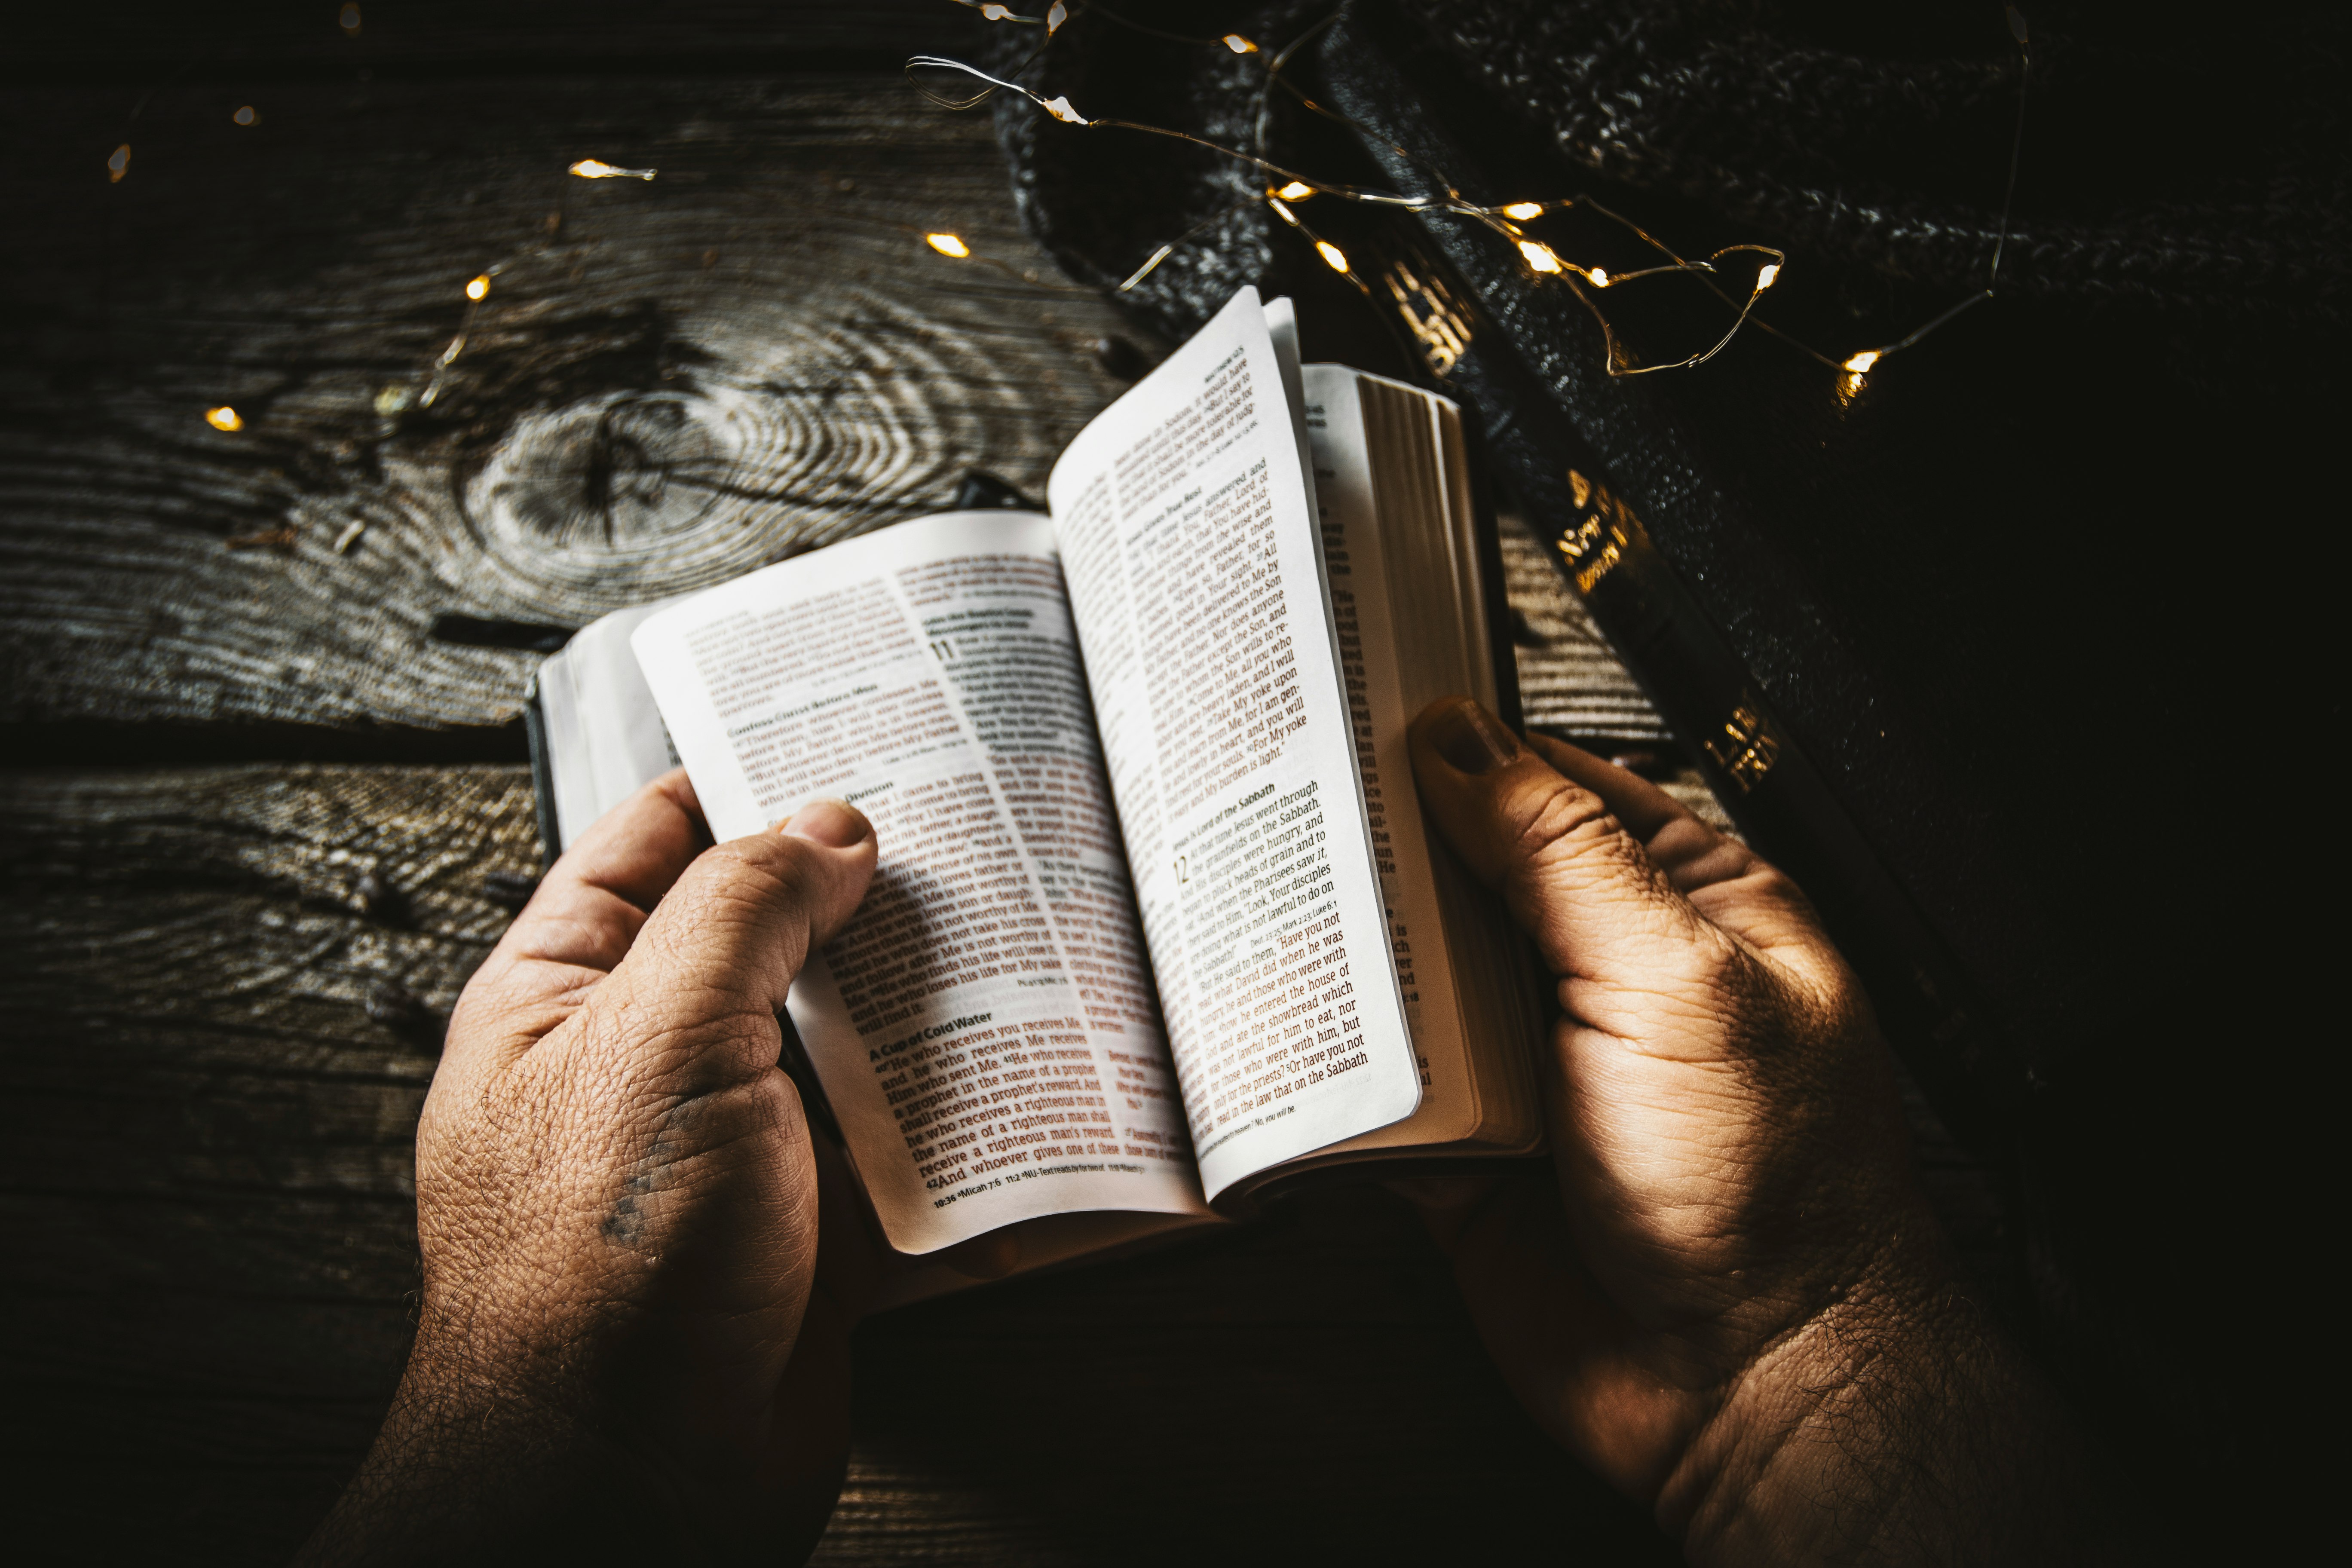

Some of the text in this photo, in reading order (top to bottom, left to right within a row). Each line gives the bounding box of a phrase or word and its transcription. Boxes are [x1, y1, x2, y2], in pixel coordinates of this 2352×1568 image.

[929, 640, 954, 661] 11
[727, 718, 773, 738] Confess
[775, 705, 810, 722] Christ
[811, 693, 850, 710] Before
[1269, 726, 1285, 743] My
[1286, 714, 1307, 736] yoke
[1250, 760, 1257, 772] is
[845, 781, 894, 804] Division
[1197, 819, 1214, 836] Lord
[1215, 811, 1222, 824] of
[1224, 805, 1237, 819] the
[1238, 783, 1275, 809] Sabbath
[1199, 838, 1214, 855] that
[1215, 827, 1232, 844] time
[1234, 815, 1255, 834] Jesus
[1256, 801, 1279, 821] went
[1279, 780, 1318, 808] through
[1173, 855, 1189, 886] 12
[1250, 900, 1337, 948] Deut. 23:25; Mark 2:23; Luke 6:1
[870, 1012, 992, 1062] A Cup of Cold Water
[911, 1045, 941, 1062] who
[943, 1029, 995, 1051] receives
[997, 1024, 1020, 1038] you
[1022, 1018, 1065, 1032] receives
[1065, 1017, 1083, 1030] Me,
[1205, 981, 1354, 1060] God and ate the showbread which
[1208, 1000, 1356, 1077] was not lawful for him to eat, nor
[881, 1034, 1087, 1091] and he who receives Me receives
[886, 1086, 917, 1106] Him
[916, 1075, 946, 1093] who
[949, 1064, 977, 1081] sent
[977, 1059, 1002, 1073] Me.
[1030, 1050, 1055, 1061] who
[1055, 1050, 1092, 1060] receives
[1211, 1016, 1360, 1094] for those who were with him, but
[1214, 1094, 1226, 1111] only
[1228, 1088, 1237, 1102] for
[1239, 1082, 1252, 1096] the
[1254, 1065, 1285, 1091] priests?
[1302, 1050, 1325, 1069] have
[1326, 1042, 1346, 1060] you
[1347, 1033, 1364, 1051] not
[894, 1064, 1096, 1120] a prophet in the name of a prophet
[900, 1079, 1102, 1134] shall receive a prophet's reward. And
[1216, 1051, 1368, 1127] read in the law that on the Sabbath
[905, 1096, 1106, 1148] he who receives a righteous man in
[912, 1111, 1111, 1162] the name of a righteous man shall
[1256, 1106, 1296, 1126] No, you will be.
[918, 1127, 1115, 1179] receive a righteous man's reward.
[971, 1151, 1028, 1175] whoever
[1033, 1145, 1063, 1160] gives
[1067, 1144, 1084, 1155] one
[1087, 1143, 1096, 1155] of
[1098, 1142, 1119, 1154] these
[934, 1195, 956, 1209] 10:36
[987, 1178, 1001, 1190] 7:6
[1005, 1174, 1020, 1184] 11:2
[1054, 1165, 1071, 1174] reads
[1071, 1165, 1078, 1173] by
